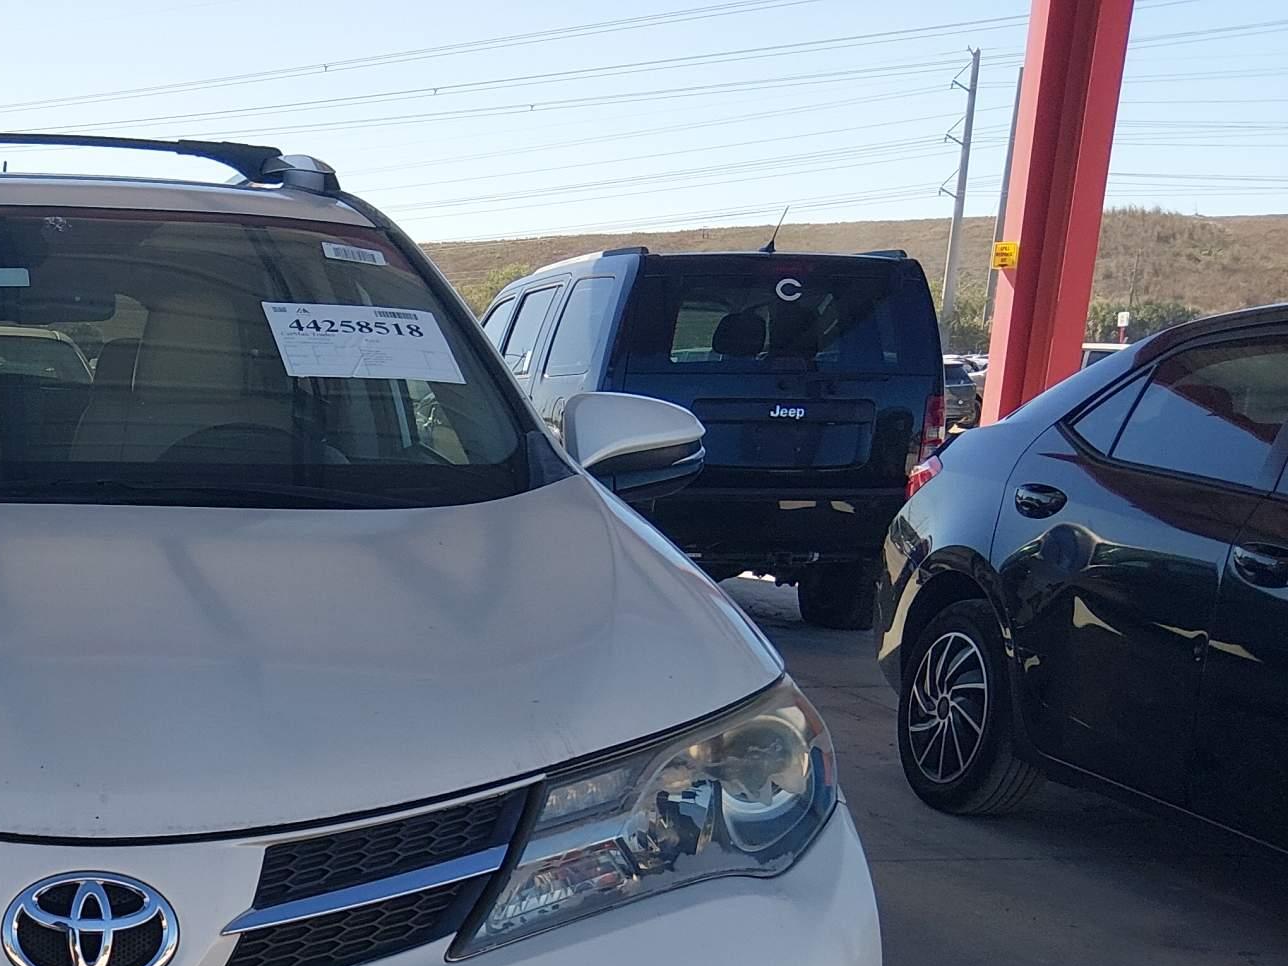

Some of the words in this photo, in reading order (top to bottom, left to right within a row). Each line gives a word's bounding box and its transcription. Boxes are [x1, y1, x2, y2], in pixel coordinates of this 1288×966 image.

[776, 278, 802, 301] C
[289, 319, 424, 338] 44258518
[770, 404, 805, 420] Jeep
